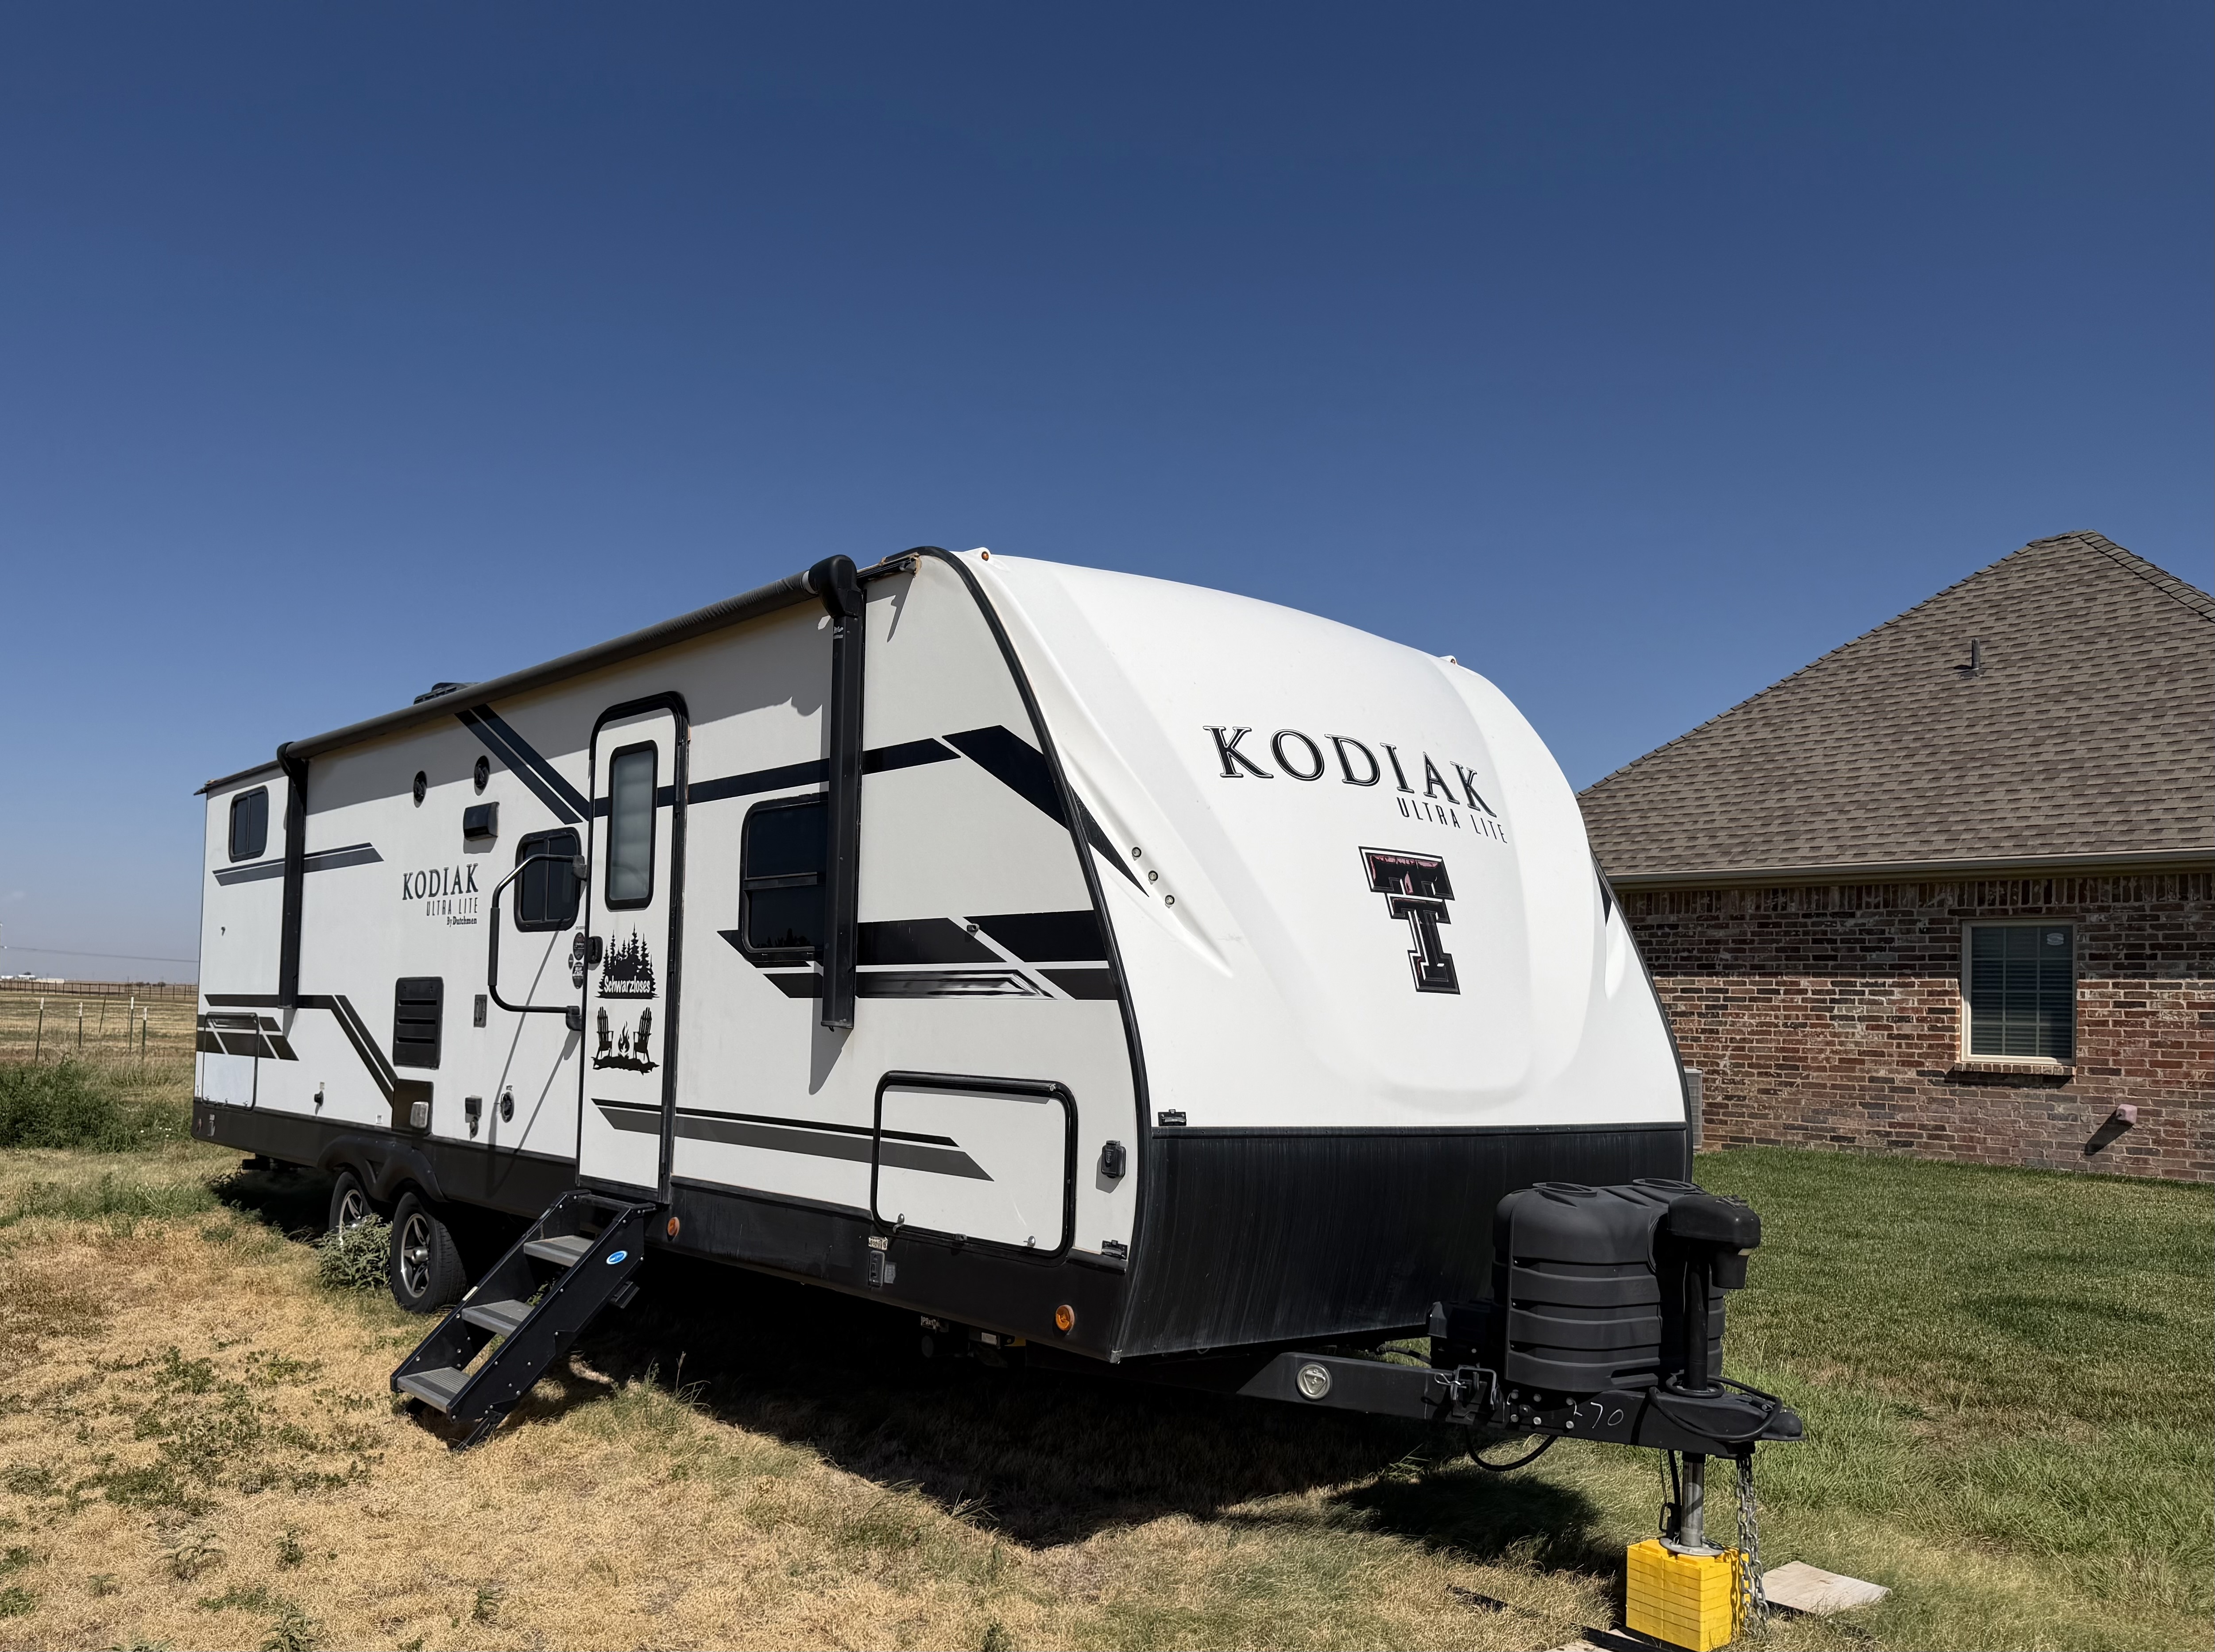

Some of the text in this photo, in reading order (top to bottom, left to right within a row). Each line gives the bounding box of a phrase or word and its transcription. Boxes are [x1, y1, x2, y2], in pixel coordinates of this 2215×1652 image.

[1202, 725, 1497, 818] KODIAK
[1396, 797, 1508, 843] ULTRA LITE
[402, 863, 479, 901] KODIAK
[426, 897, 479, 916] ULTRA LITE
[446, 915, 477, 928] By Dutchmen
[603, 975, 650, 993] Schwarzloses
